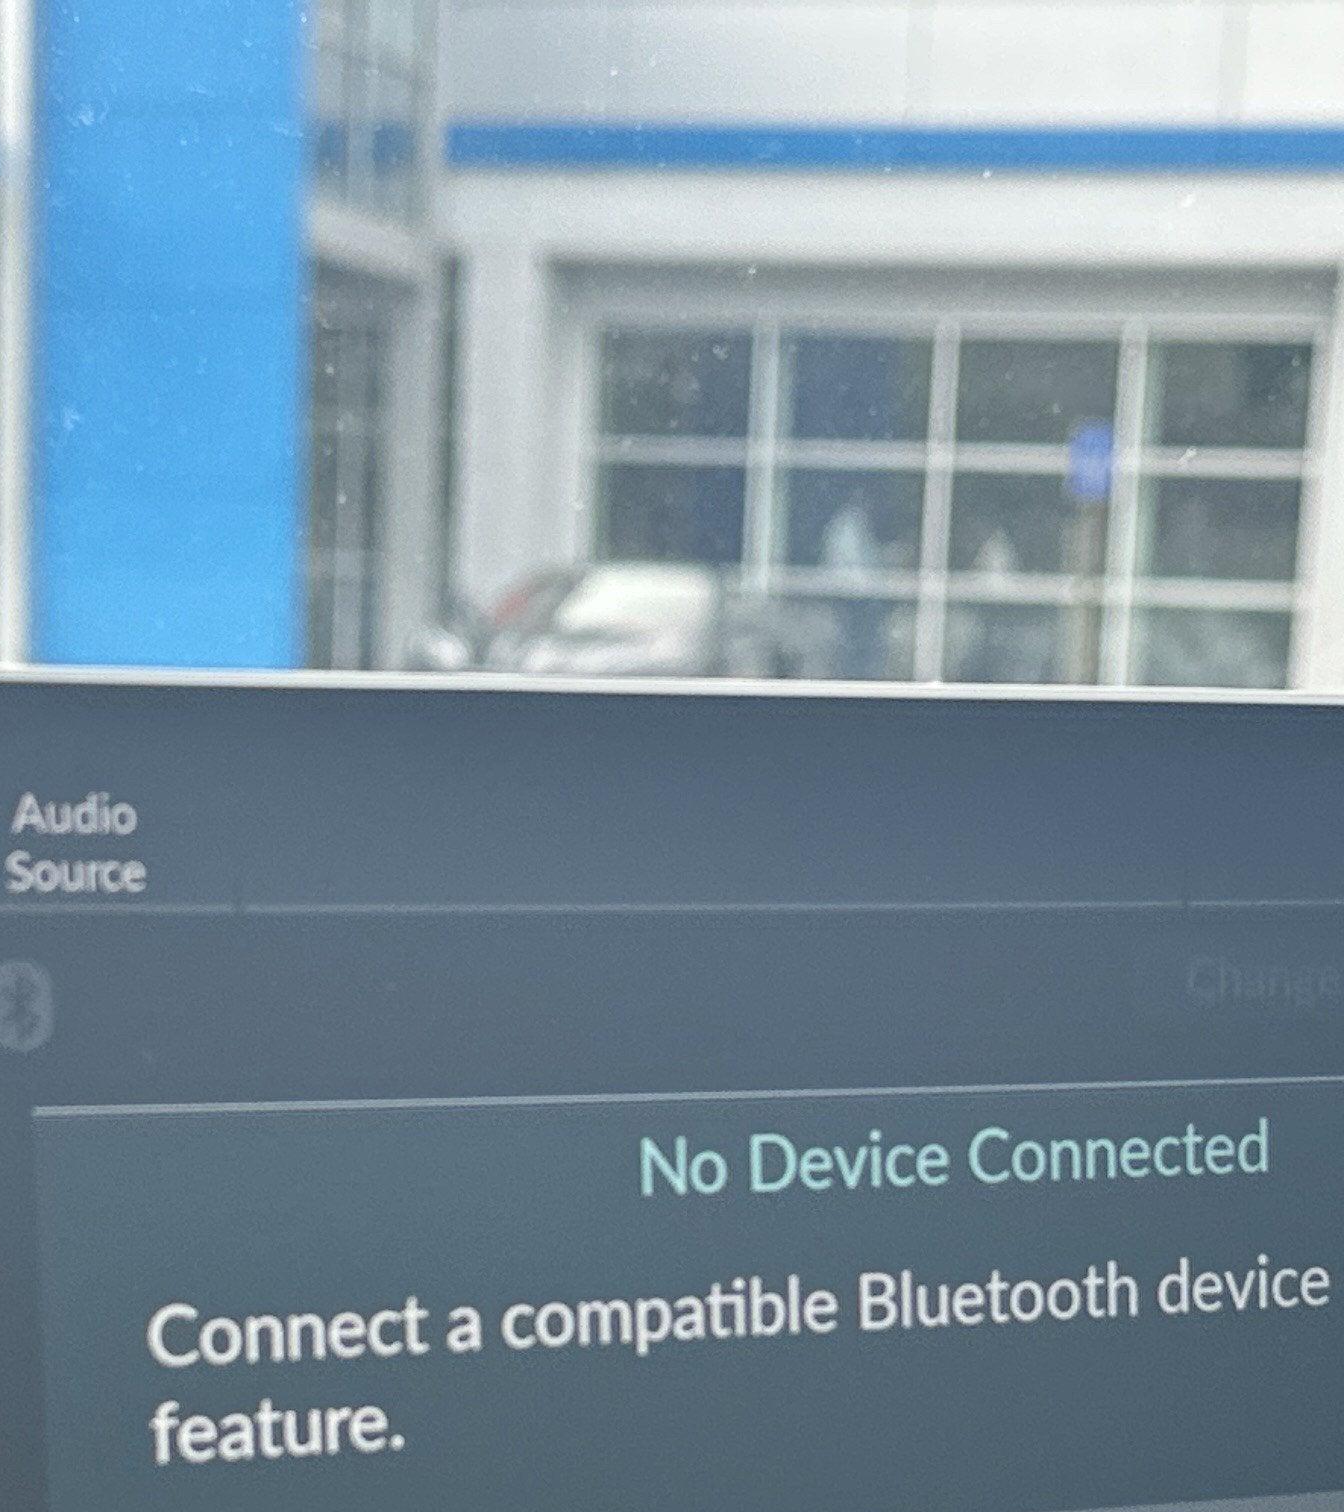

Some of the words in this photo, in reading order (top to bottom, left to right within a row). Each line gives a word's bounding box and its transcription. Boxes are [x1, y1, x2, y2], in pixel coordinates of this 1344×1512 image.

[11, 791, 138, 835] Audio
[4, 849, 147, 893] Source
[640, 1136, 727, 1196] No
[750, 1130, 949, 1193] Device
[968, 1118, 1269, 1184] Connected
[147, 1296, 428, 1367] Connect
[446, 1306, 482, 1353] a
[501, 1274, 838, 1356] compatible
[859, 1261, 1138, 1331] Bluetooth
[1157, 1254, 1330, 1315] device
[151, 1397, 405, 1466] feature.
